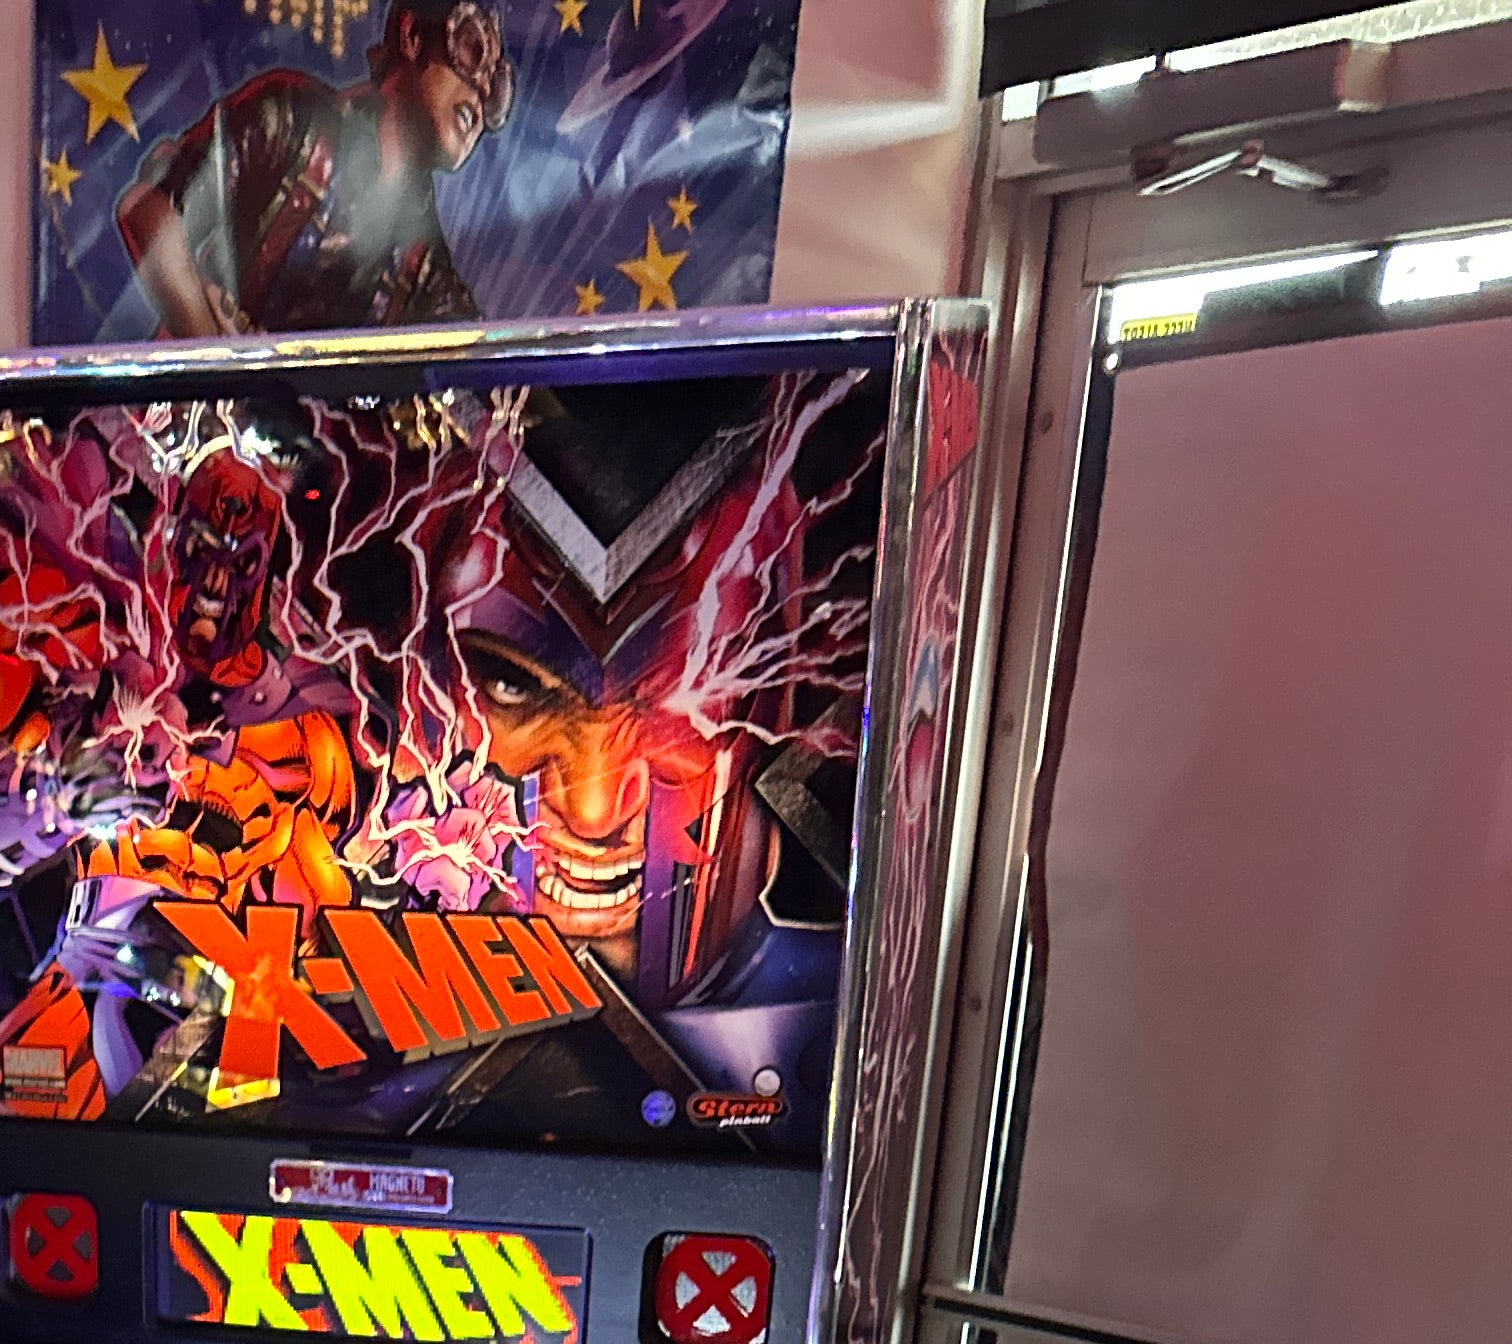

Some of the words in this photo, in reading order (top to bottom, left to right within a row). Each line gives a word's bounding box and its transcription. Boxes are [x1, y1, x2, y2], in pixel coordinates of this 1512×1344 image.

[152, 899, 604, 1080] X-MEN
[698, 1100, 777, 1118] Stern
[719, 1113, 771, 1128] pinball
[180, 1210, 573, 1342] X-MEN
